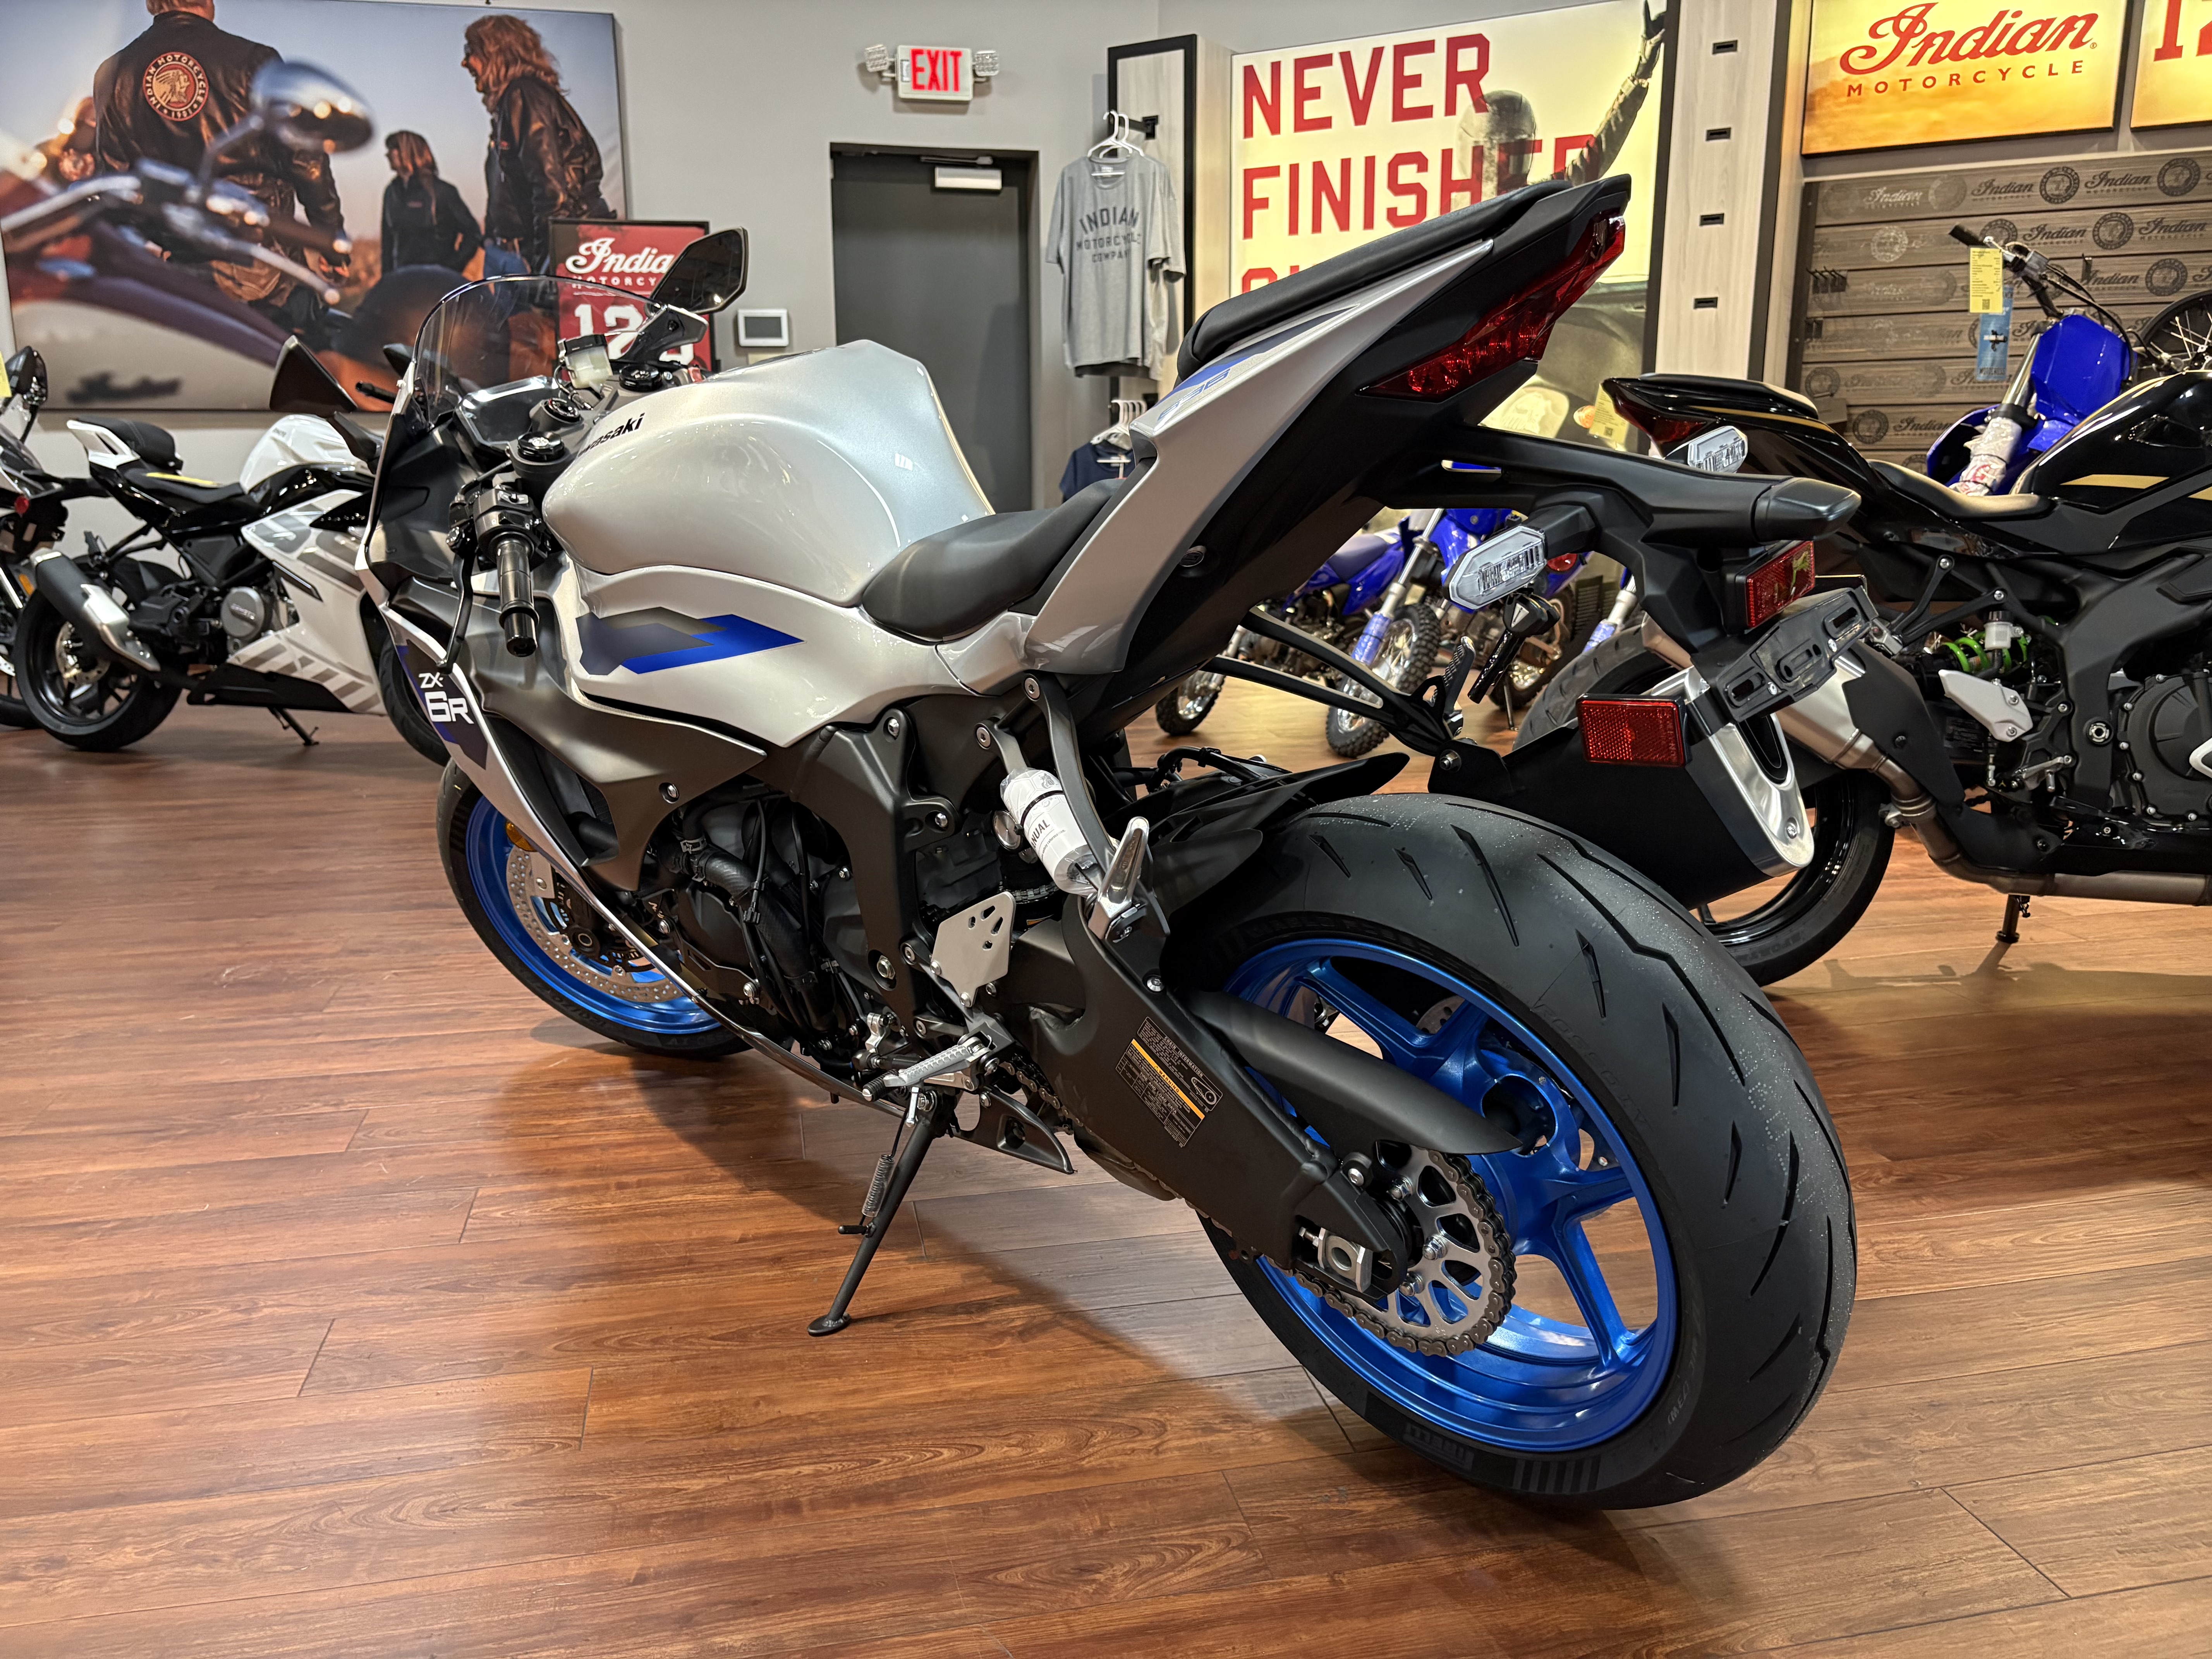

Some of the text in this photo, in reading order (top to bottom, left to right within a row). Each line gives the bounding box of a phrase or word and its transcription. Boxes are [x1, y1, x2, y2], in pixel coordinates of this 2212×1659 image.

[1839, 2, 2099, 75] Indian
[910, 48, 963, 92] EXIT
[1846, 60, 2085, 98] MOTORCYCLE
[1243, 33, 1490, 139] NEVER
[1971, 179, 2033, 196] Indian
[2084, 170, 2152, 189] Indian
[1079, 206, 1139, 234] INDIAN
[2022, 223, 2087, 241] Indian
[2138, 217, 2207, 235] Indian
[565, 237, 675, 274] India
[1076, 232, 1142, 251] MOTORCYCLE
[572, 276, 657, 289] MOTORCY
[425, 691, 474, 725] 6R
[1031, 819, 1051, 849] ANUAL
[1164, 1036, 1176, 1050] CHAIN
[1178, 1050, 1203, 1077] INFORMATION
[1159, 1070, 1180, 1093] WARNING
[1157, 1091, 1167, 1103] LOAD
[1167, 1102, 1177, 1114] DATA
